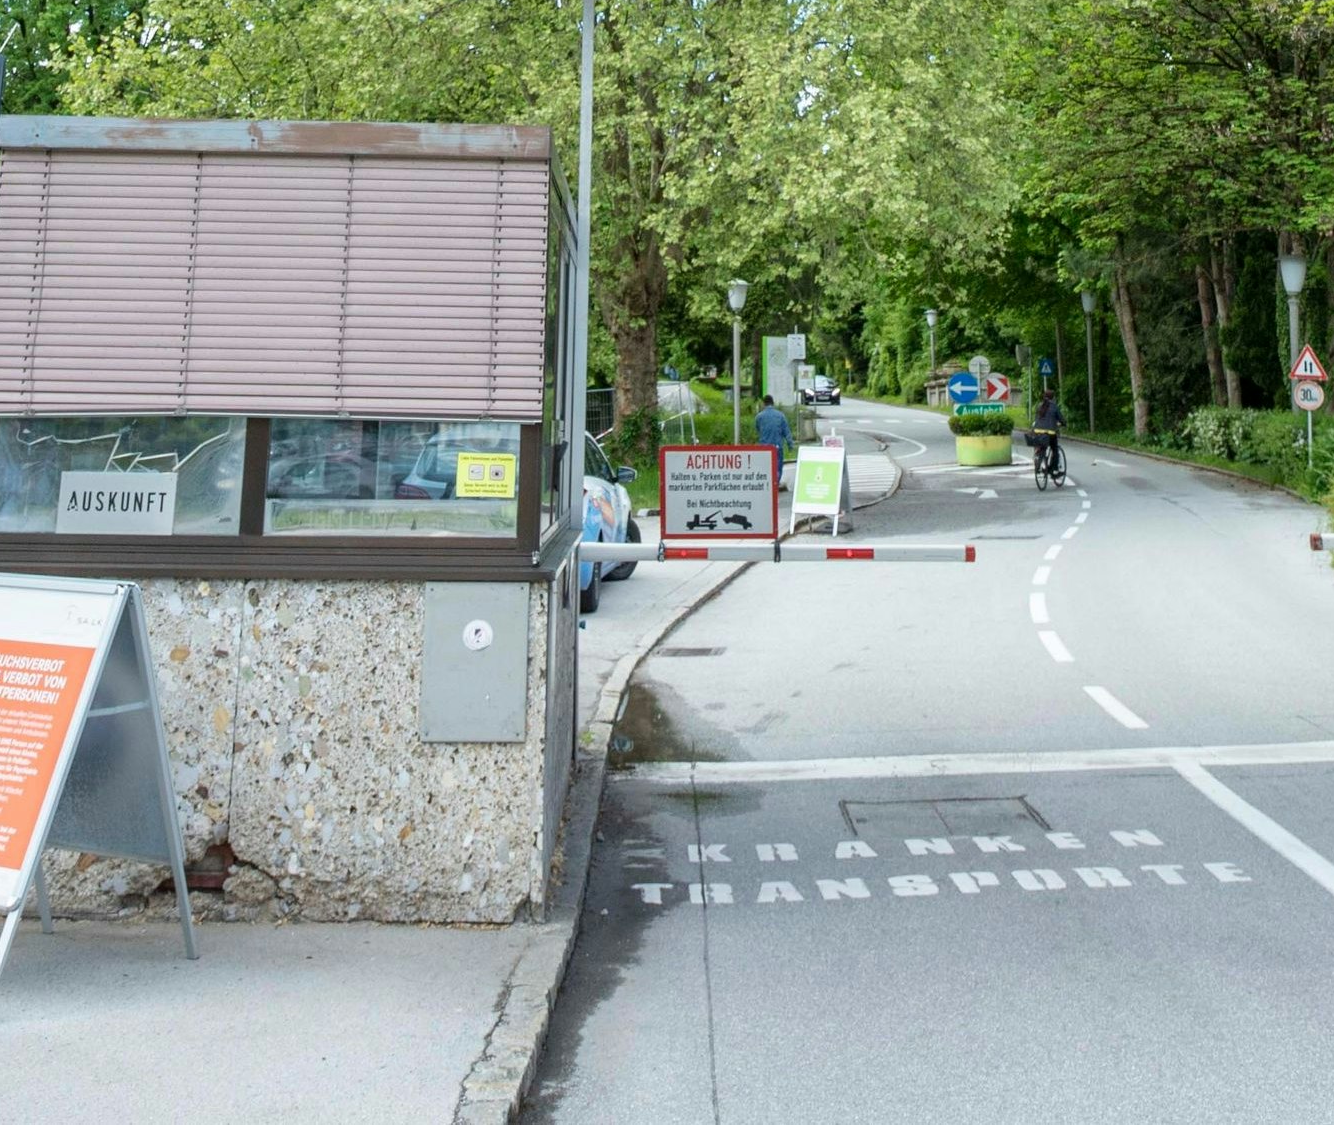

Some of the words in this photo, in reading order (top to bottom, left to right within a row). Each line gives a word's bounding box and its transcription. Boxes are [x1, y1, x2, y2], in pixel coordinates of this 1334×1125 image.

[686, 454, 742, 470] ACHTUNG
[670, 472, 691, 481] Halten
[699, 471, 722, 481] Parken
[722, 471, 731, 481] ist
[732, 473, 743, 481] nur
[744, 471, 755, 481] auf
[755, 471, 768, 481] den
[668, 482, 703, 492] markierten
[704, 481, 741, 492] Parkflächen
[742, 482, 764, 492] erlaubt
[67, 490, 168, 513] AUSKUNFT
[686, 498, 697, 508] Bei
[698, 498, 752, 510] Nichtbeachtung
[2, 670, 43, 686] VERBOT
[43, 675, 68, 689] VON
[687, 829, 1165, 863] KRANKEN
[630, 860, 1253, 905] TRANSPORTE
